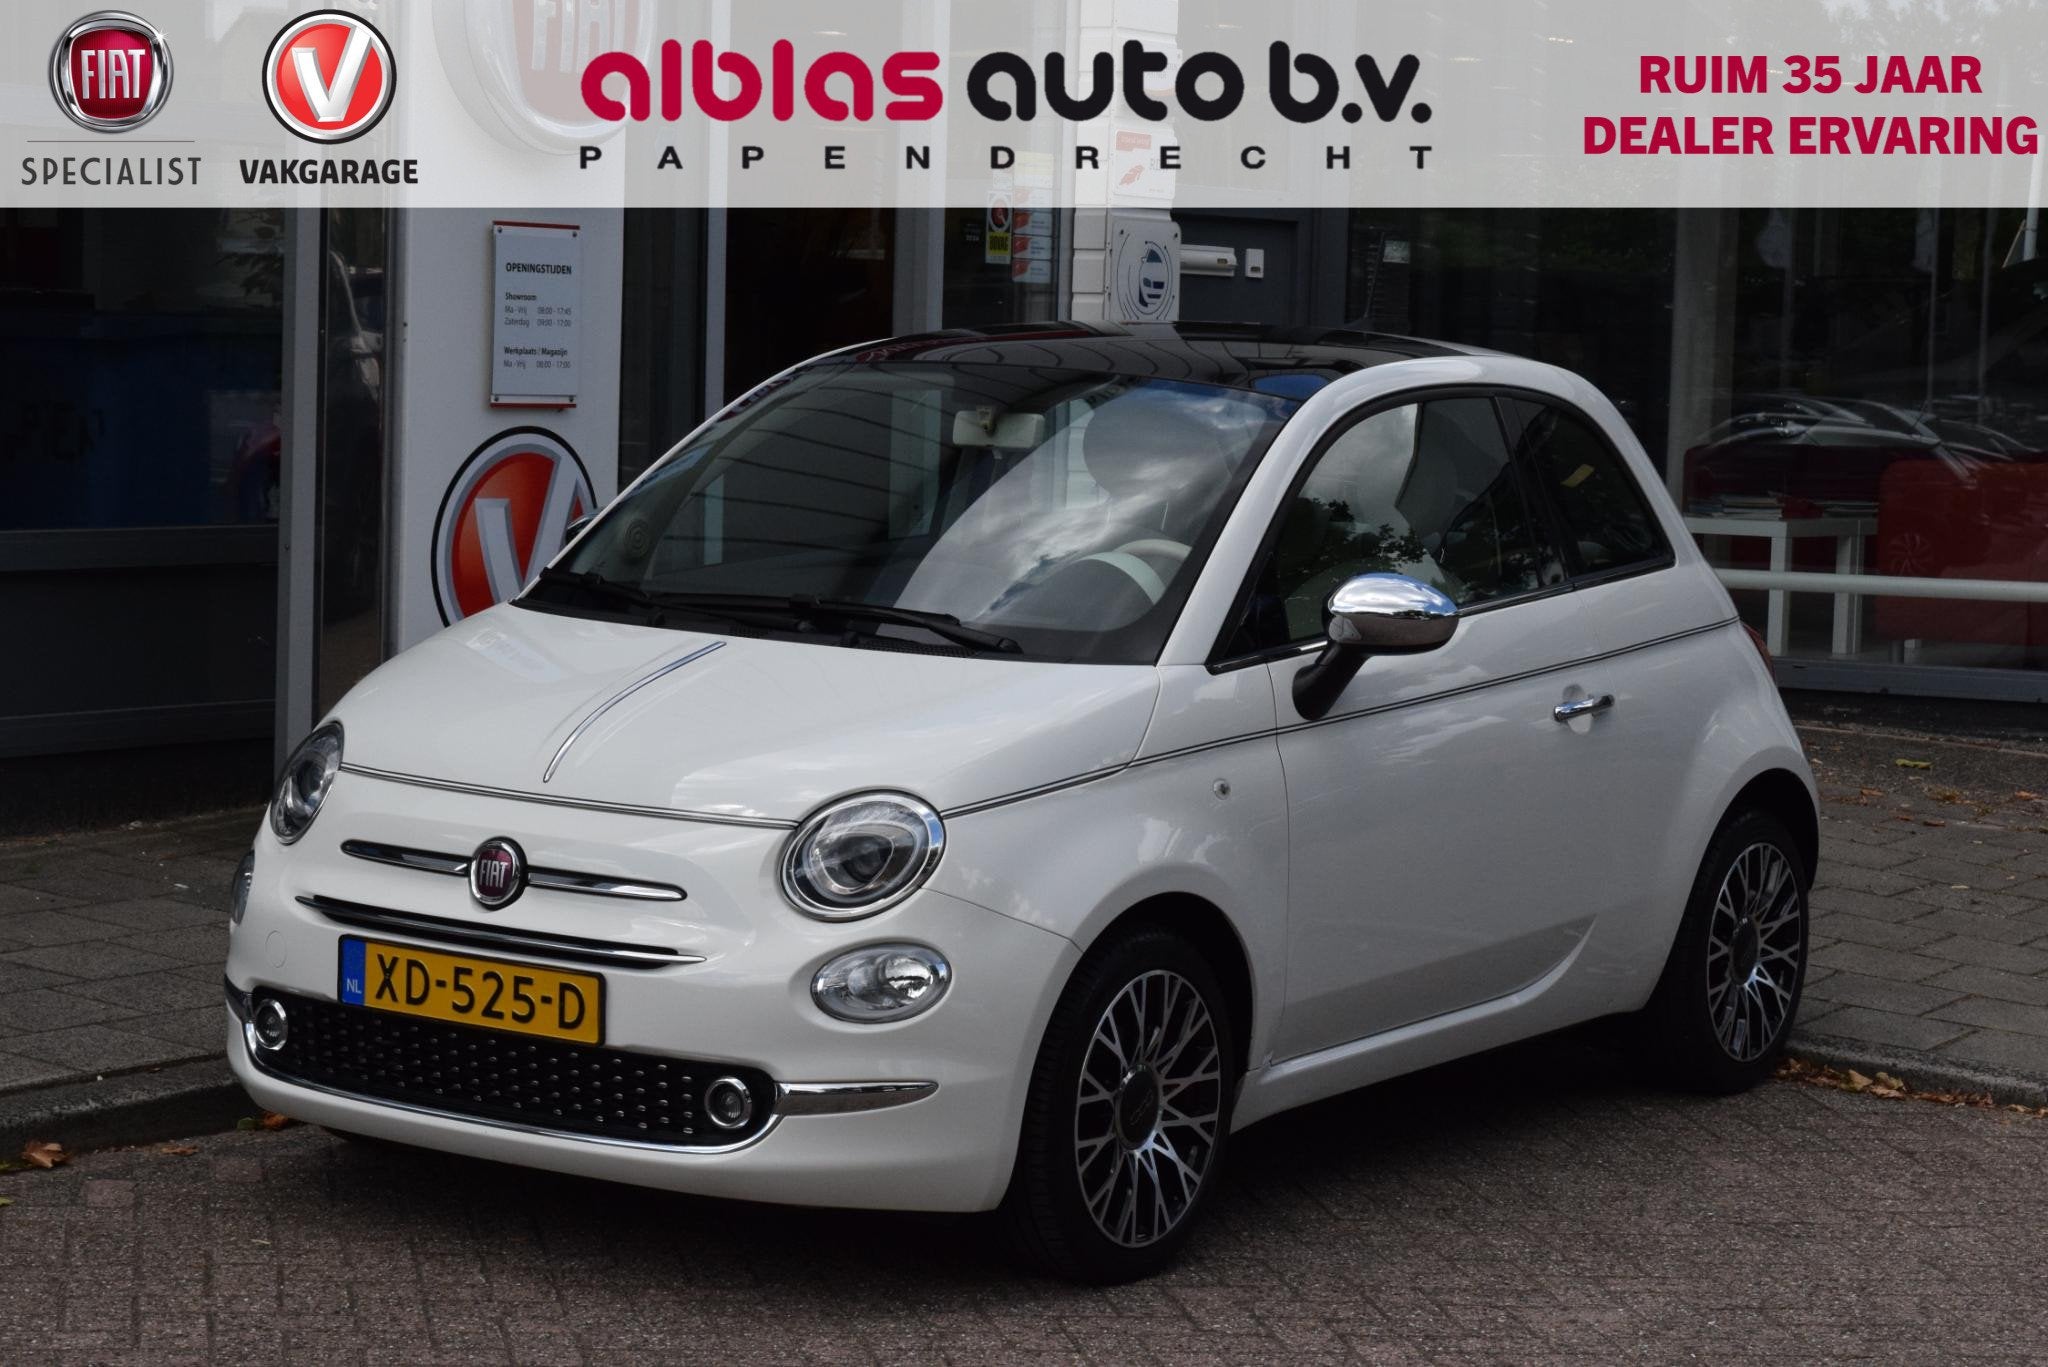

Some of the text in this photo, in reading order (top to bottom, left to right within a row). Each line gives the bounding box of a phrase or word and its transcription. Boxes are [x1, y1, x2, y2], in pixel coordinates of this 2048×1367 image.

[505, 262, 572, 275] OPENINGSTIJDEN
[505, 291, 537, 301] Showroom
[504, 318, 529, 328] Zaterdag
[504, 346, 536, 356] Werkplaats
[479, 859, 508, 889] FIAT
[346, 977, 362, 995] NL
[375, 953, 586, 1031] XD-525-D
